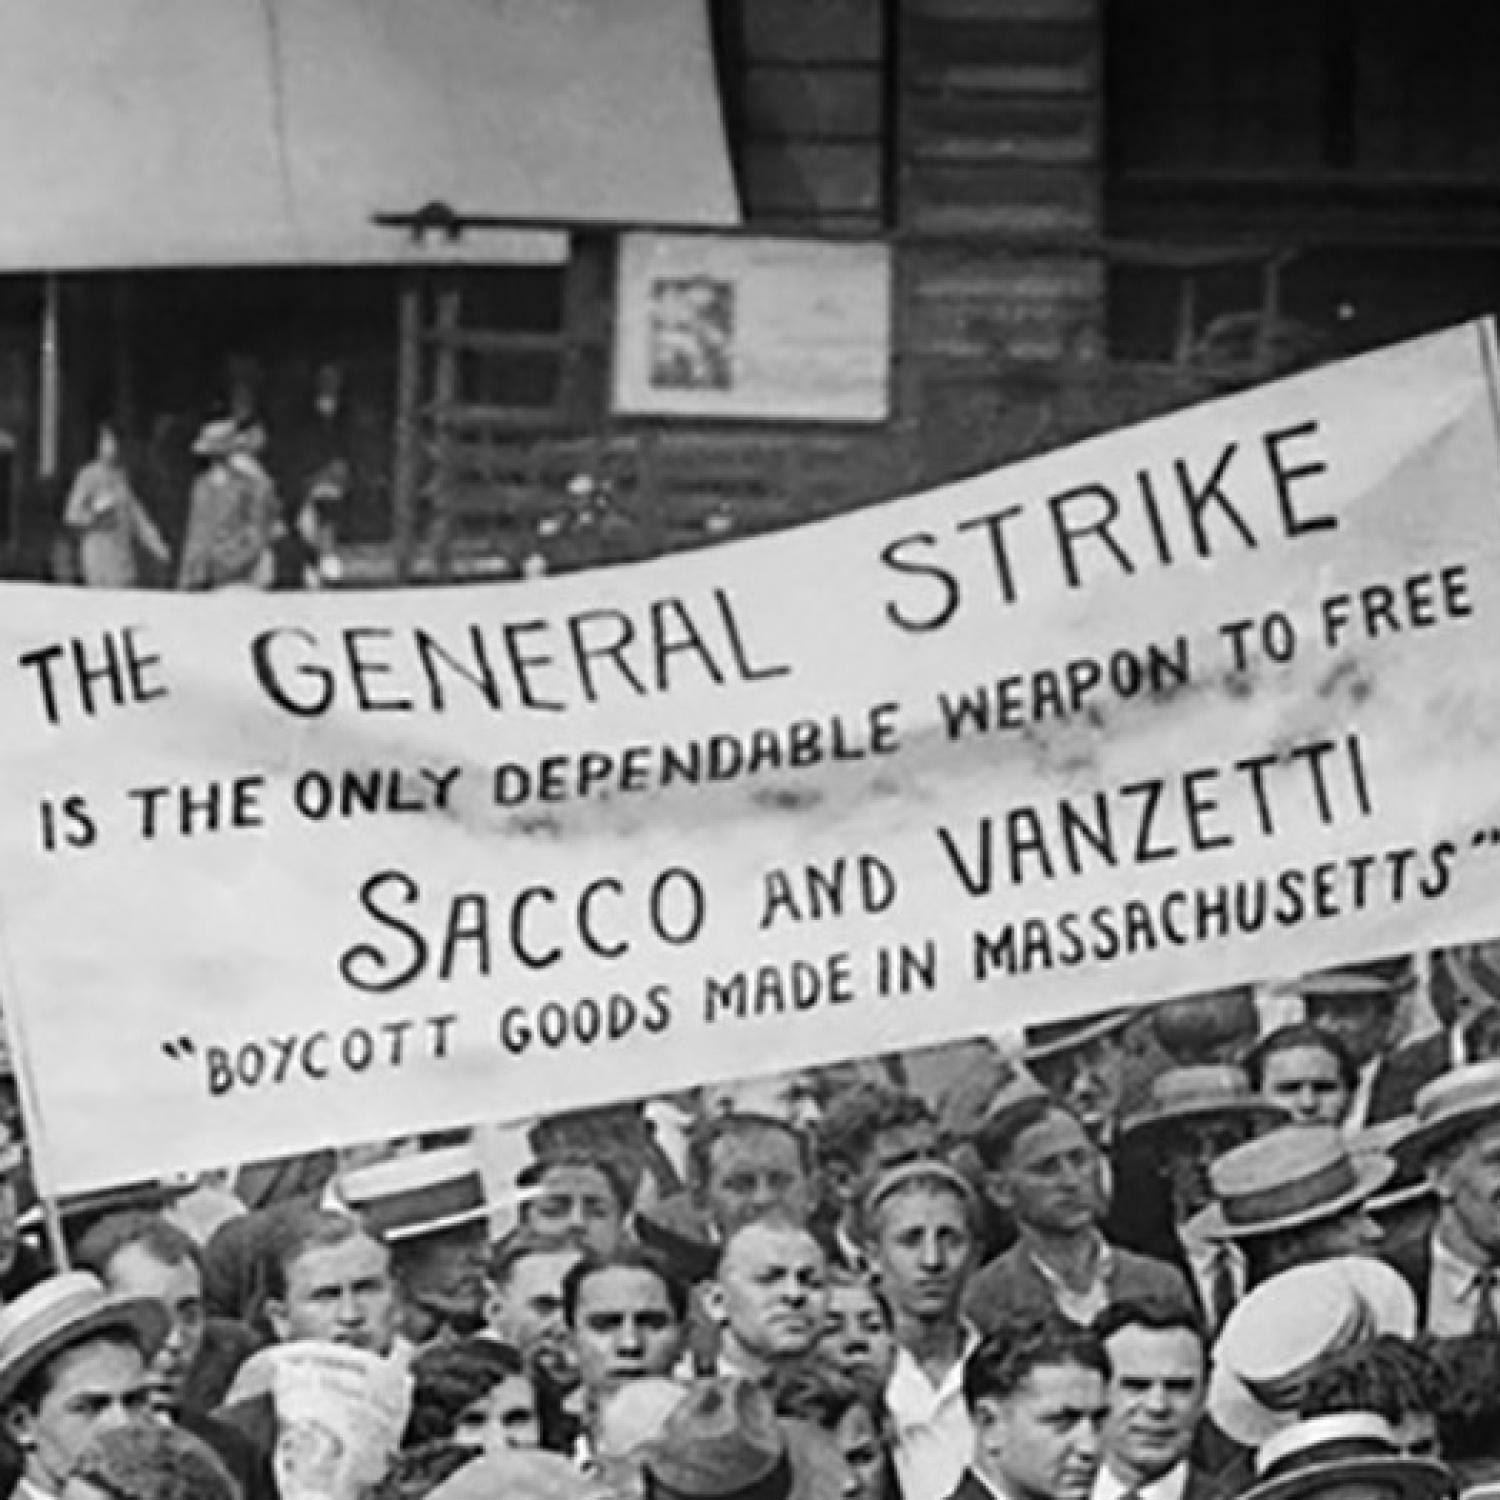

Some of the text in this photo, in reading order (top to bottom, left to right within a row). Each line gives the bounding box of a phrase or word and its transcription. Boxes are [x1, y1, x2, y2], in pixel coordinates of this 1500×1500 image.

[19, 419, 1339, 725] THE GENERAL STRIKE
[40, 564, 1474, 852] IS THE ONLY DEPENDABLE WEAPON TO FREE
[338, 734, 1373, 993] SACCO AND VANZETTI
[499, 984, 671, 1055] GOODS
[703, 957, 853, 1024] MADE
[878, 939, 937, 997] IN
